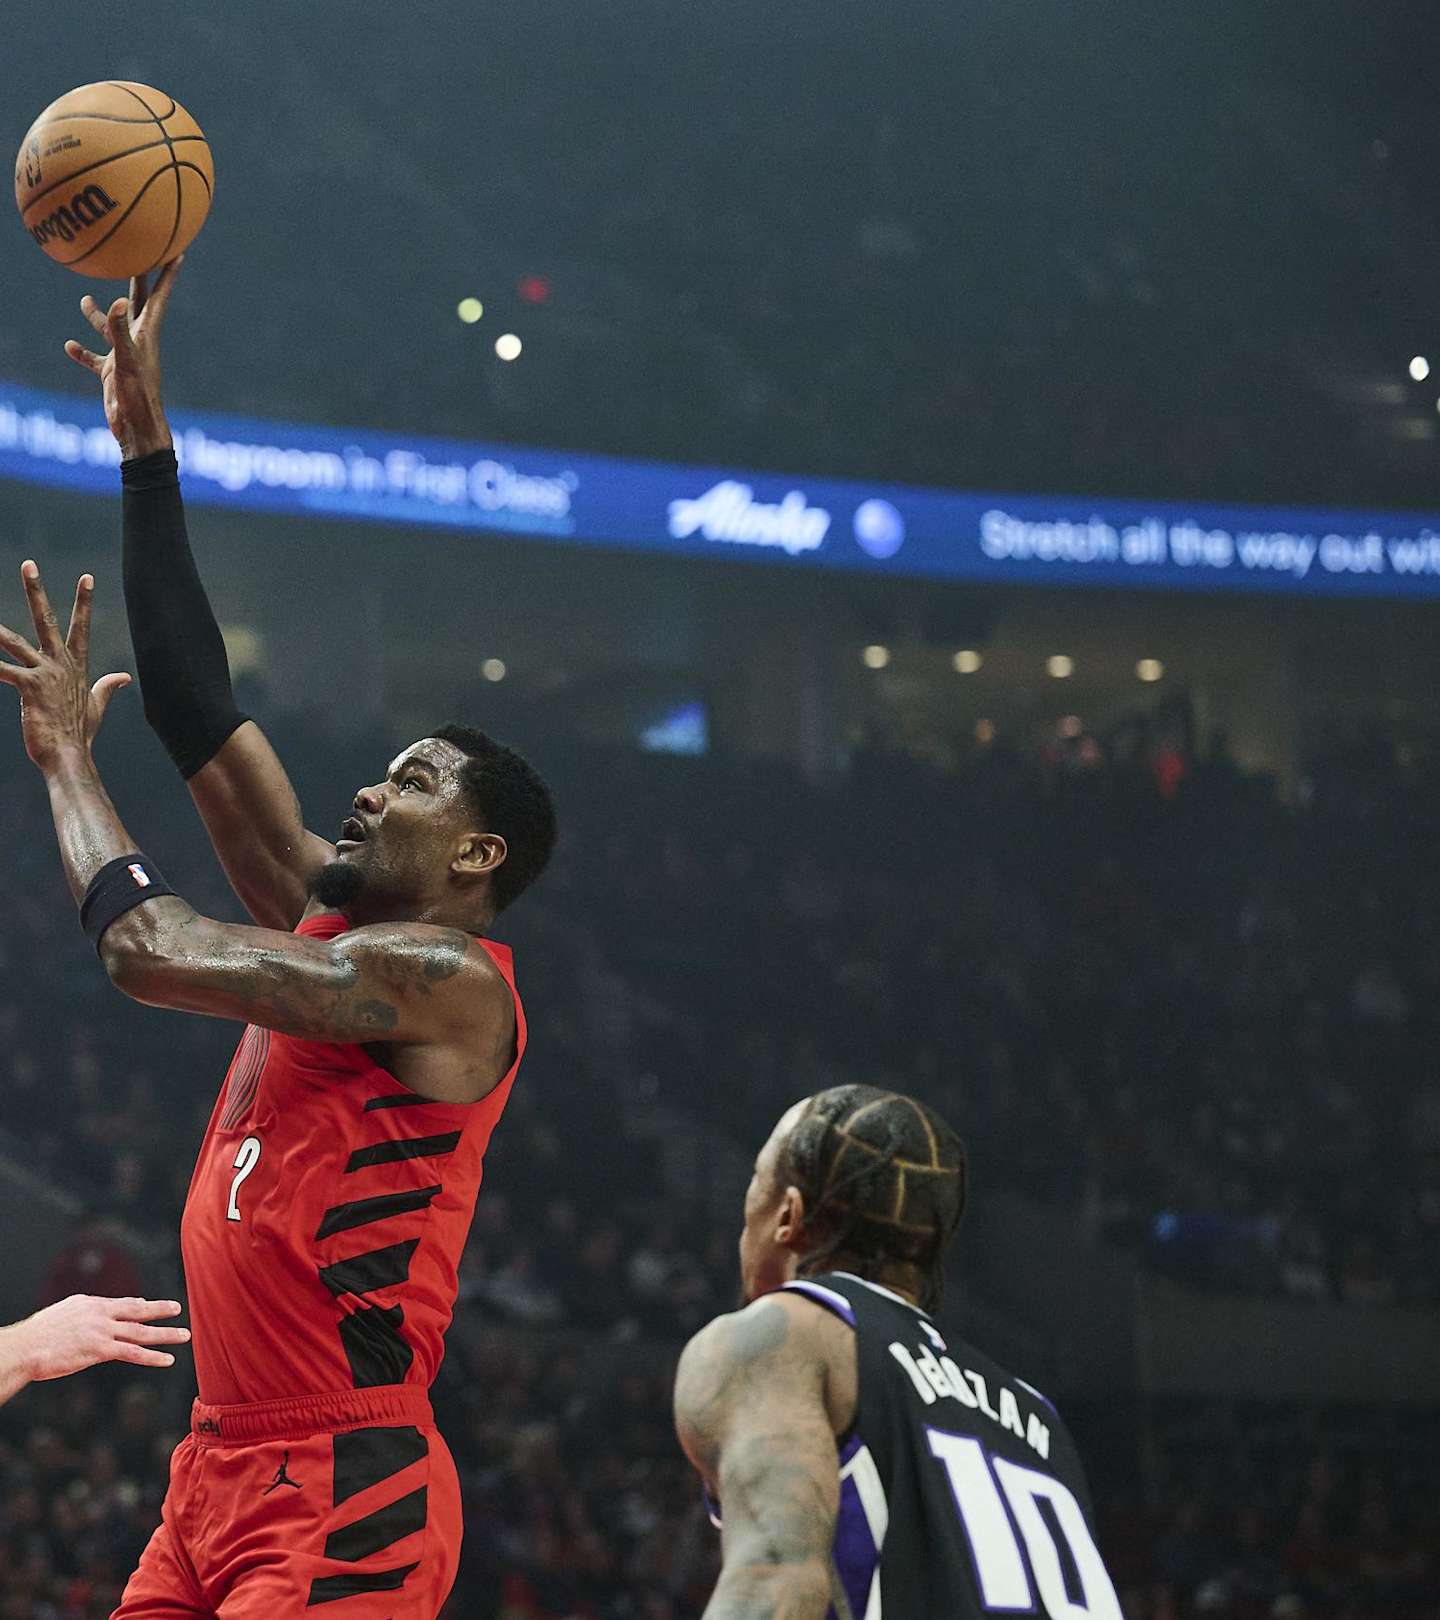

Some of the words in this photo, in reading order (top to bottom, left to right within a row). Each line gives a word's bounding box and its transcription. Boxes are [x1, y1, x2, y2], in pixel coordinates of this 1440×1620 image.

[21, 408, 85, 465] the
[184, 427, 347, 492] legroom
[343, 445, 386, 493] in
[385, 449, 467, 506] First
[980, 509, 1119, 564] Stretch
[1119, 516, 1166, 565] all
[1168, 518, 1235, 569] the
[1235, 531, 1317, 579] way
[1318, 532, 1384, 574] out
[226, 1136, 262, 1222] 2
[922, 1423, 1127, 1620] 10
